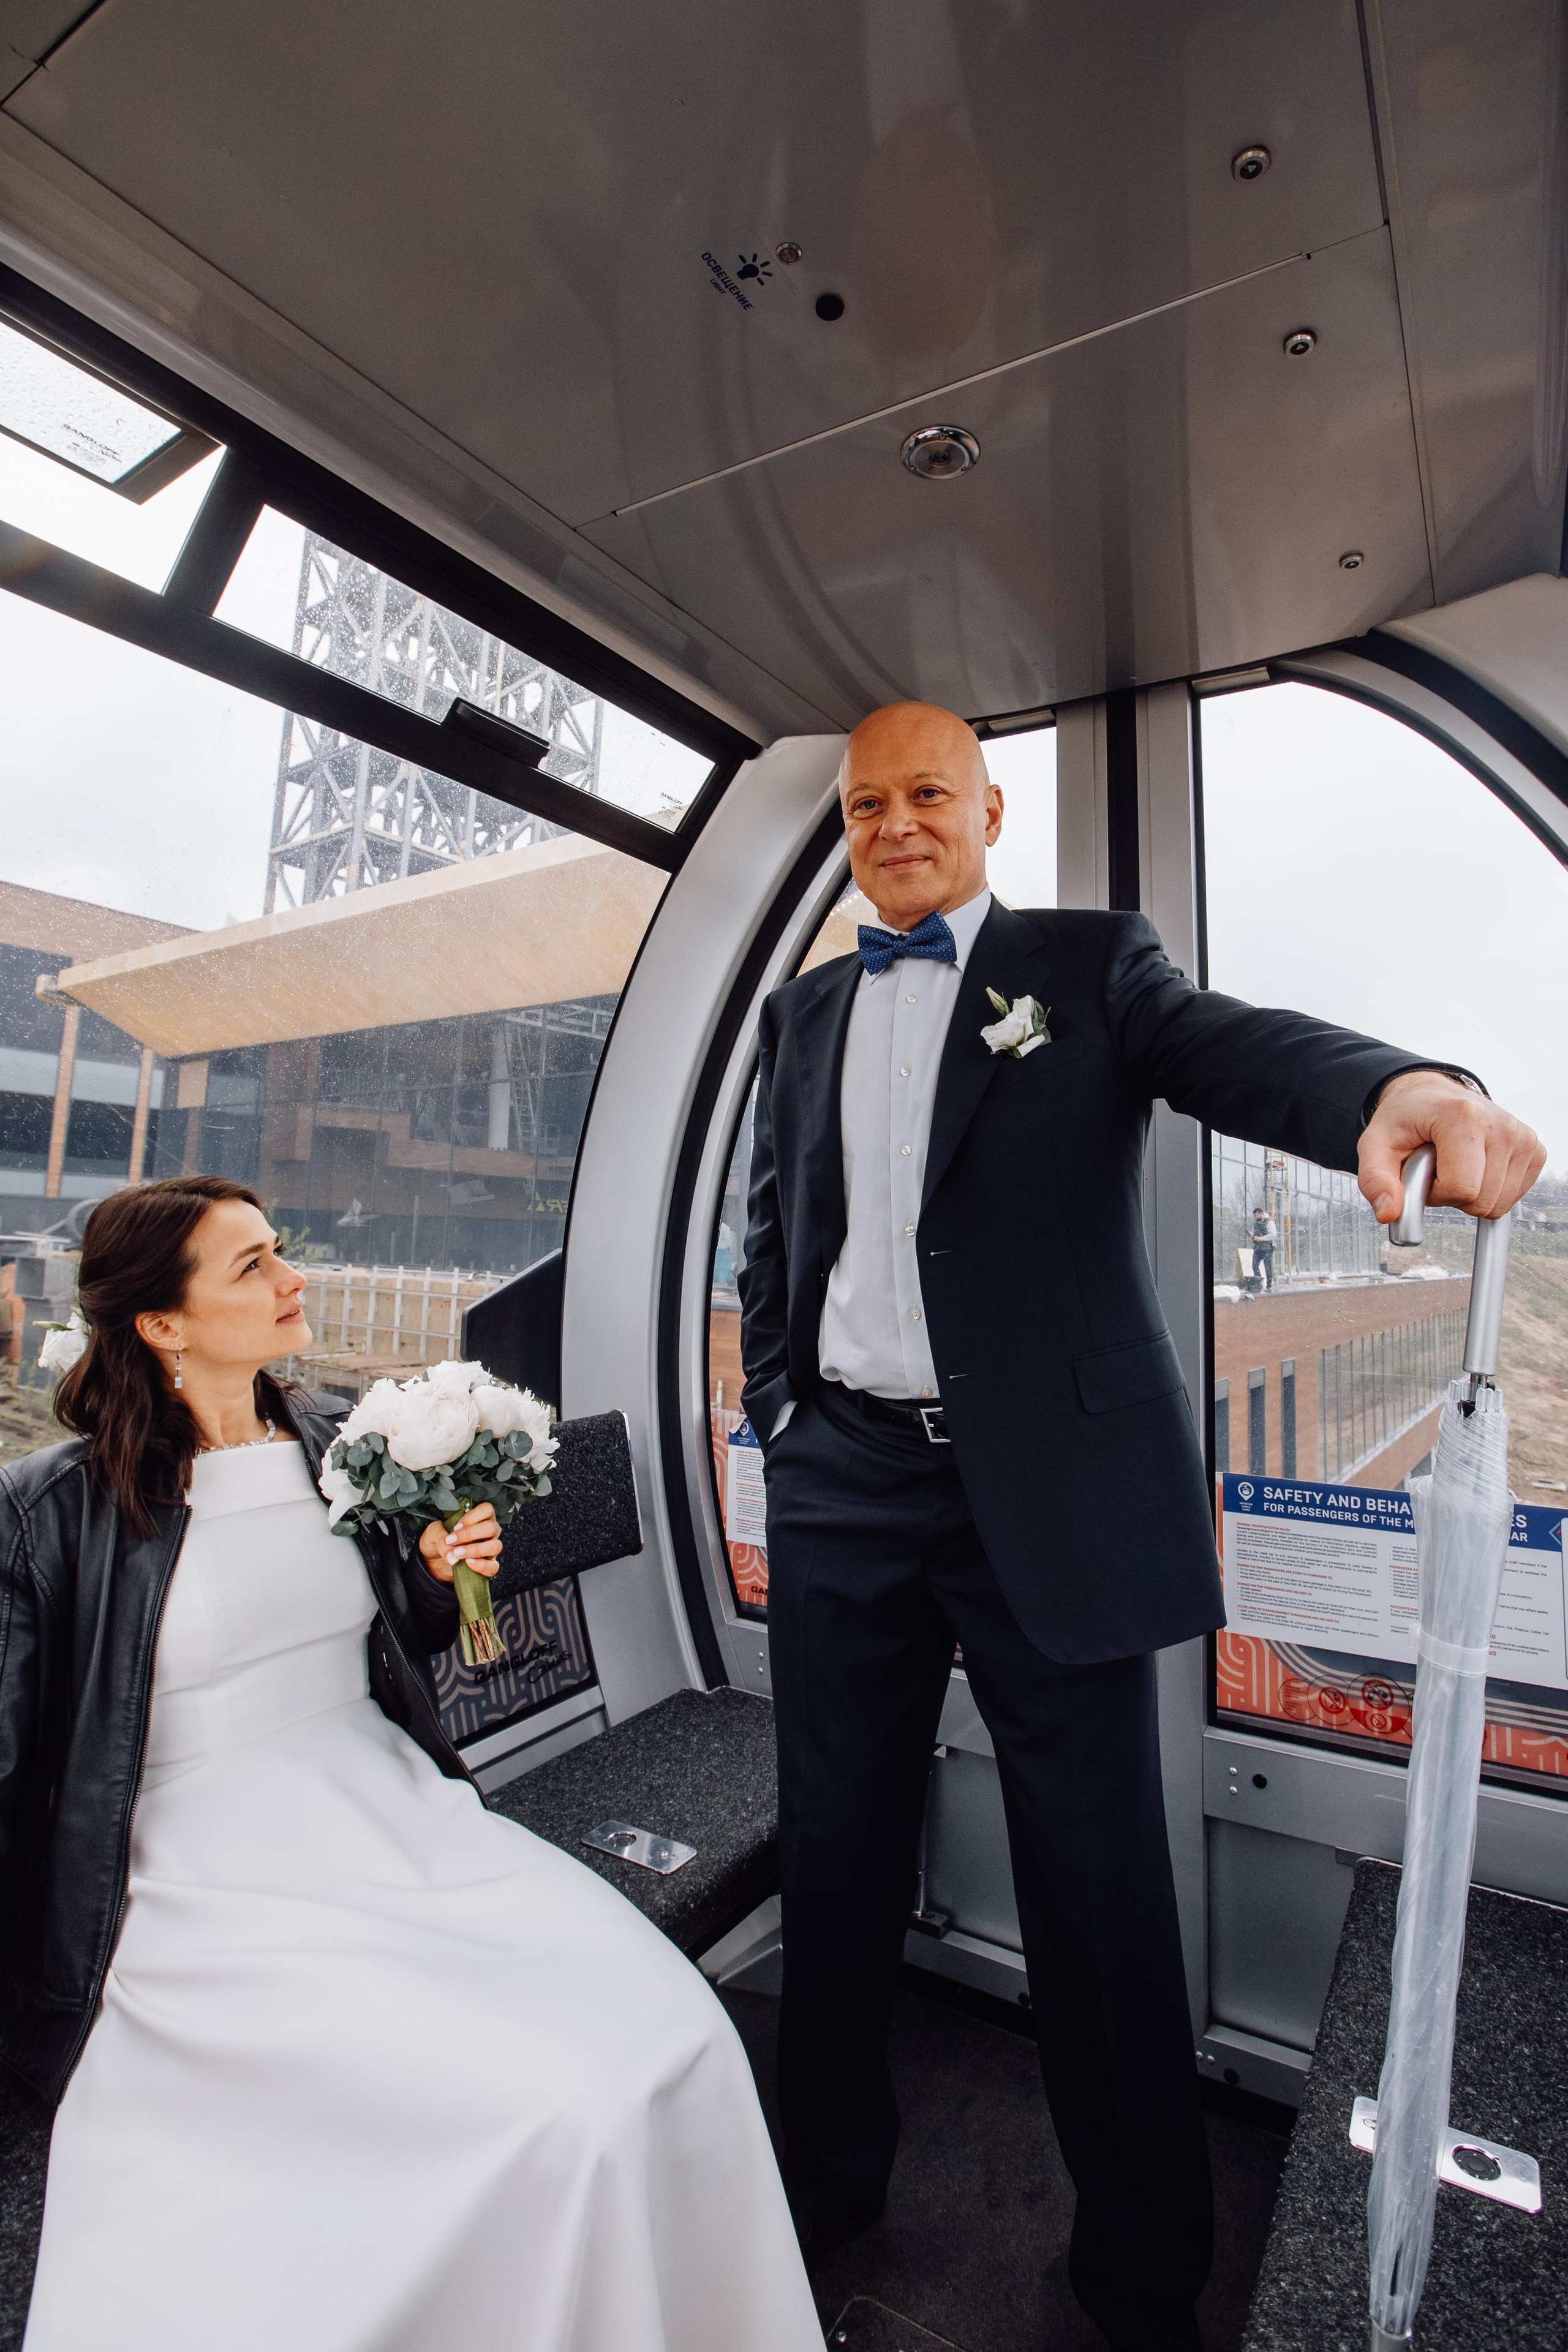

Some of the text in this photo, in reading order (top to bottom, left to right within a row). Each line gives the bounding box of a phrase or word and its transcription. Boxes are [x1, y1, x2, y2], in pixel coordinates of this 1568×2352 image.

[701, 252, 753, 311] ОСВЕЩЕНИЕ
[710, 278, 726, 294] LIGHT
[1264, 1487, 1323, 1505] SAFETY
[1327, 1493, 1360, 1509] AND
[1511, 1514, 1528, 1528] S
[1264, 1502, 1528, 1542] FOR PASSENGERS OF THE M AR
[475, 1640, 557, 1684] GANGLOFF
